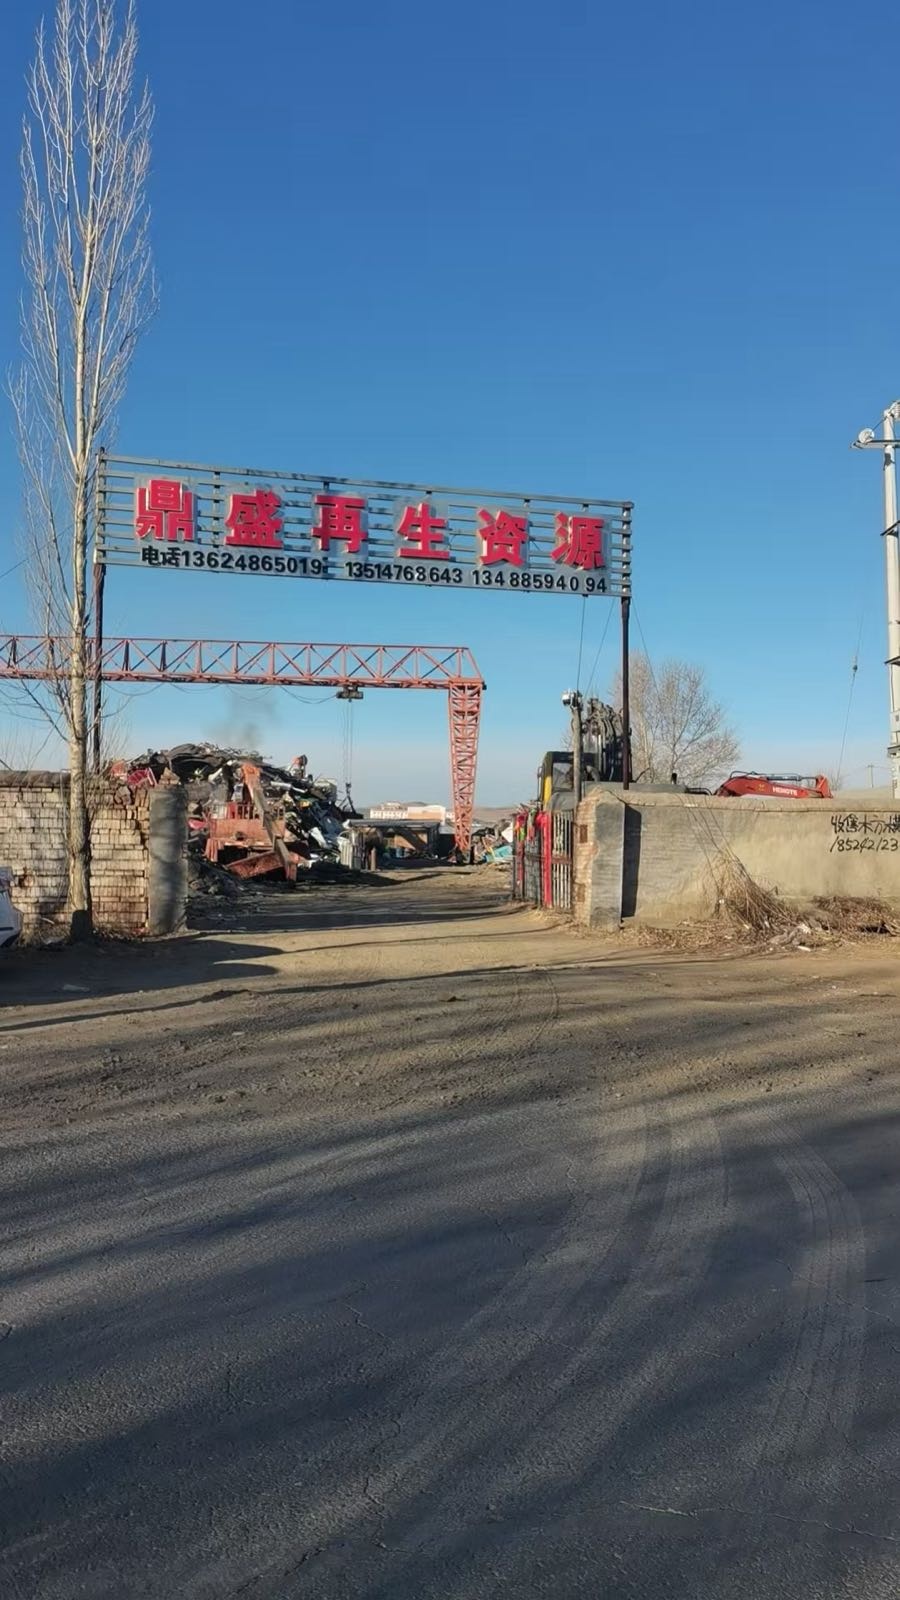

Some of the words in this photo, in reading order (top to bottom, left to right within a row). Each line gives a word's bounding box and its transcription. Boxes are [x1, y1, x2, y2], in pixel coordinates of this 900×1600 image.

[135, 479, 605, 570] 鼎盛再生资源
[345, 562, 463, 584] 13514768643
